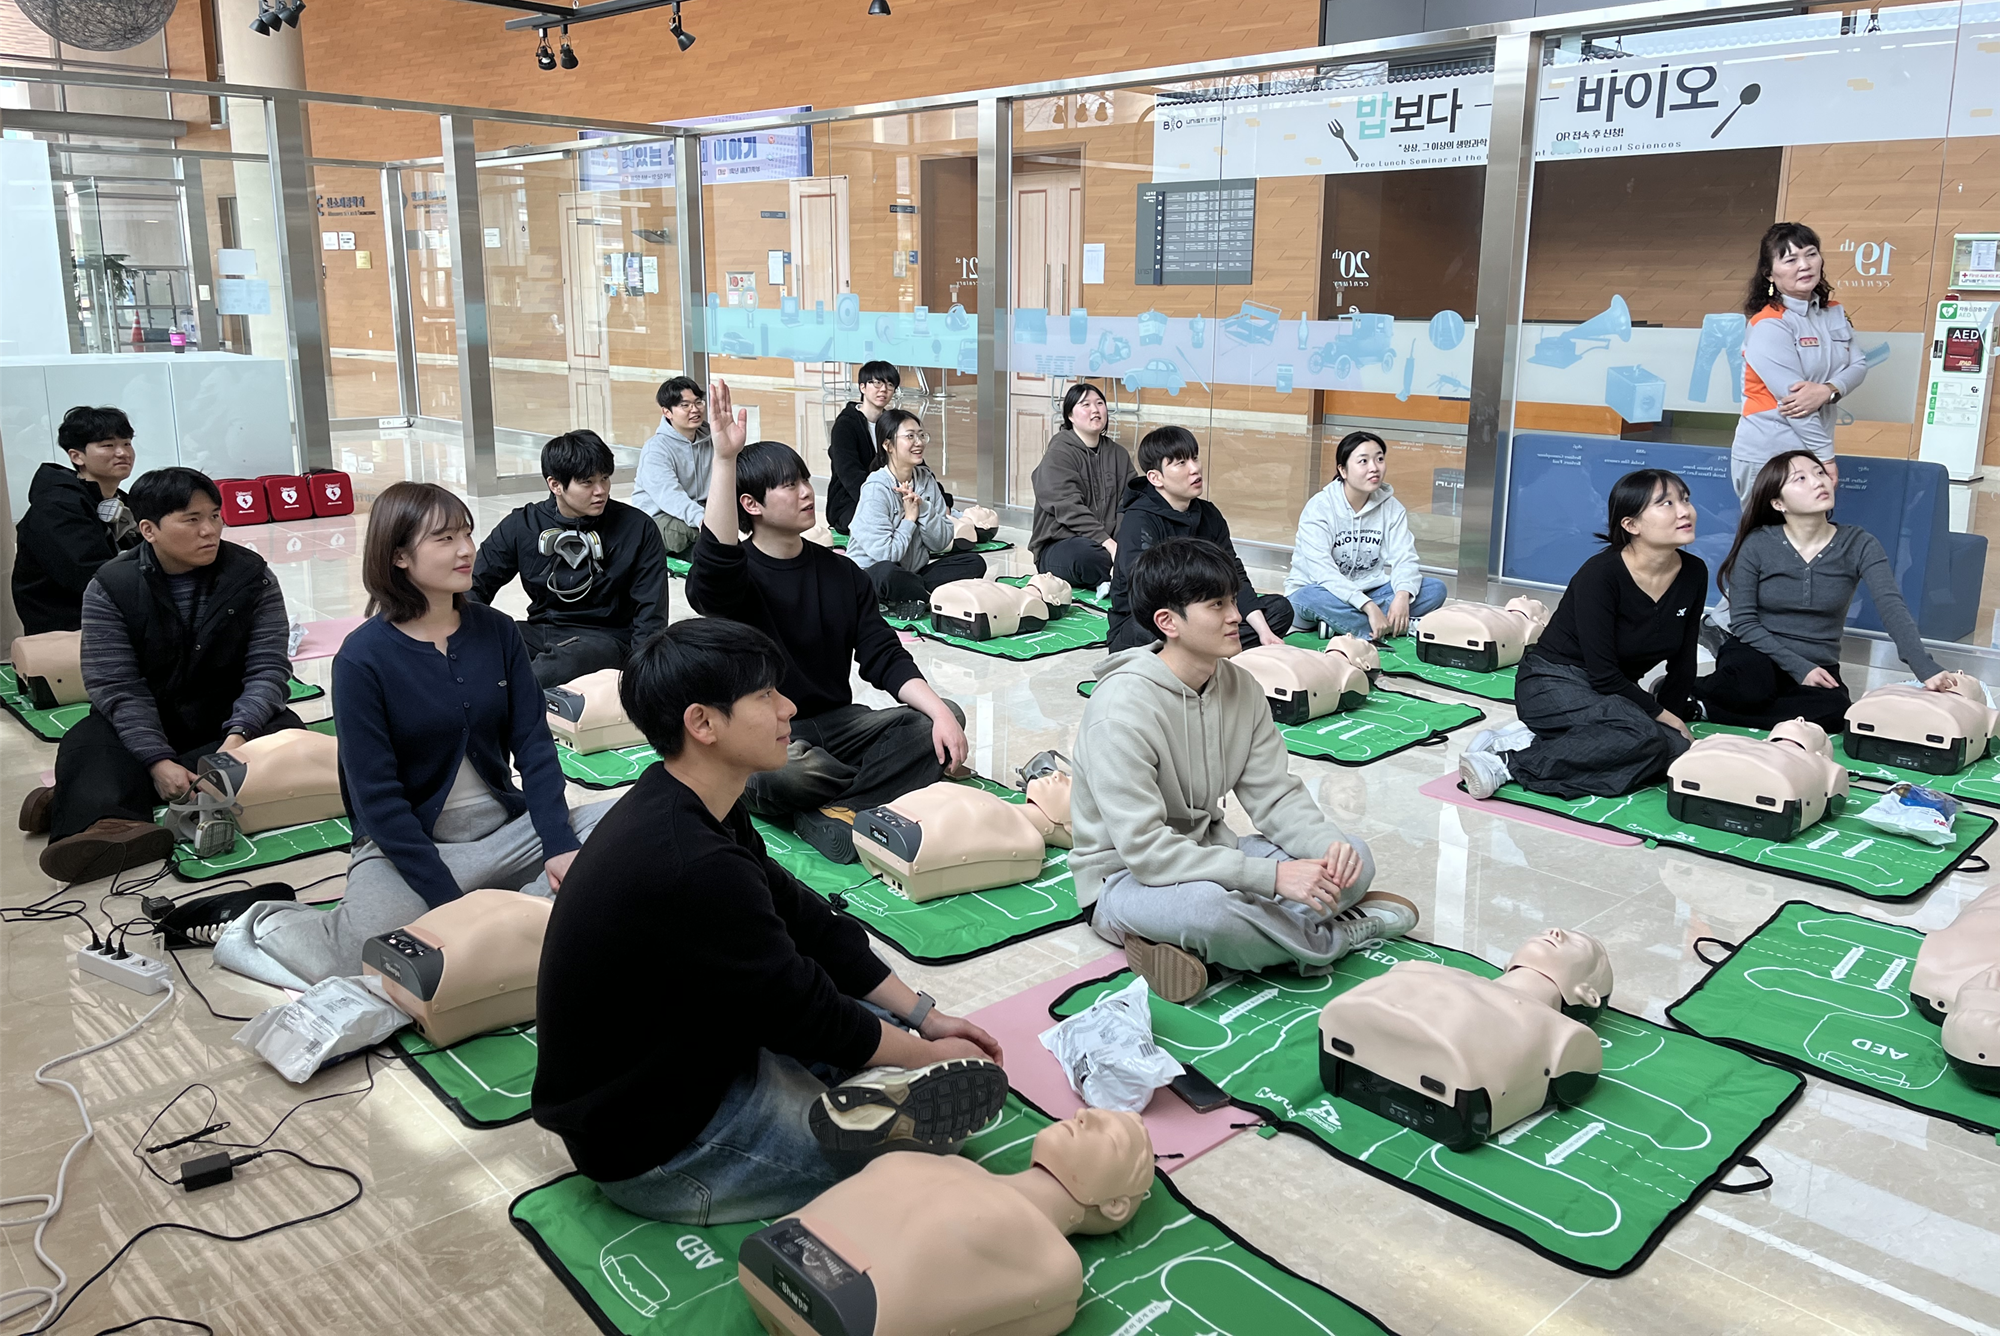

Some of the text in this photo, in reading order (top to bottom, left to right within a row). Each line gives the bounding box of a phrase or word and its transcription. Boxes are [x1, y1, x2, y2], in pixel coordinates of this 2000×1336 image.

[1576, 64, 1720, 123] 바이오
[1356, 88, 1464, 140] 밥보다
[1572, 131, 1591, 141] 접속
[1603, 128, 1624, 139] 신청!
[1627, 140, 1683, 152] Sciences
[1355, 153, 1482, 169] Free Lunch Seminar at the
[1953, 330, 1979, 339] AED
[1354, 949, 1399, 965] AED
[1851, 1038, 1909, 1060] AED
[676, 1234, 724, 1270] AED
